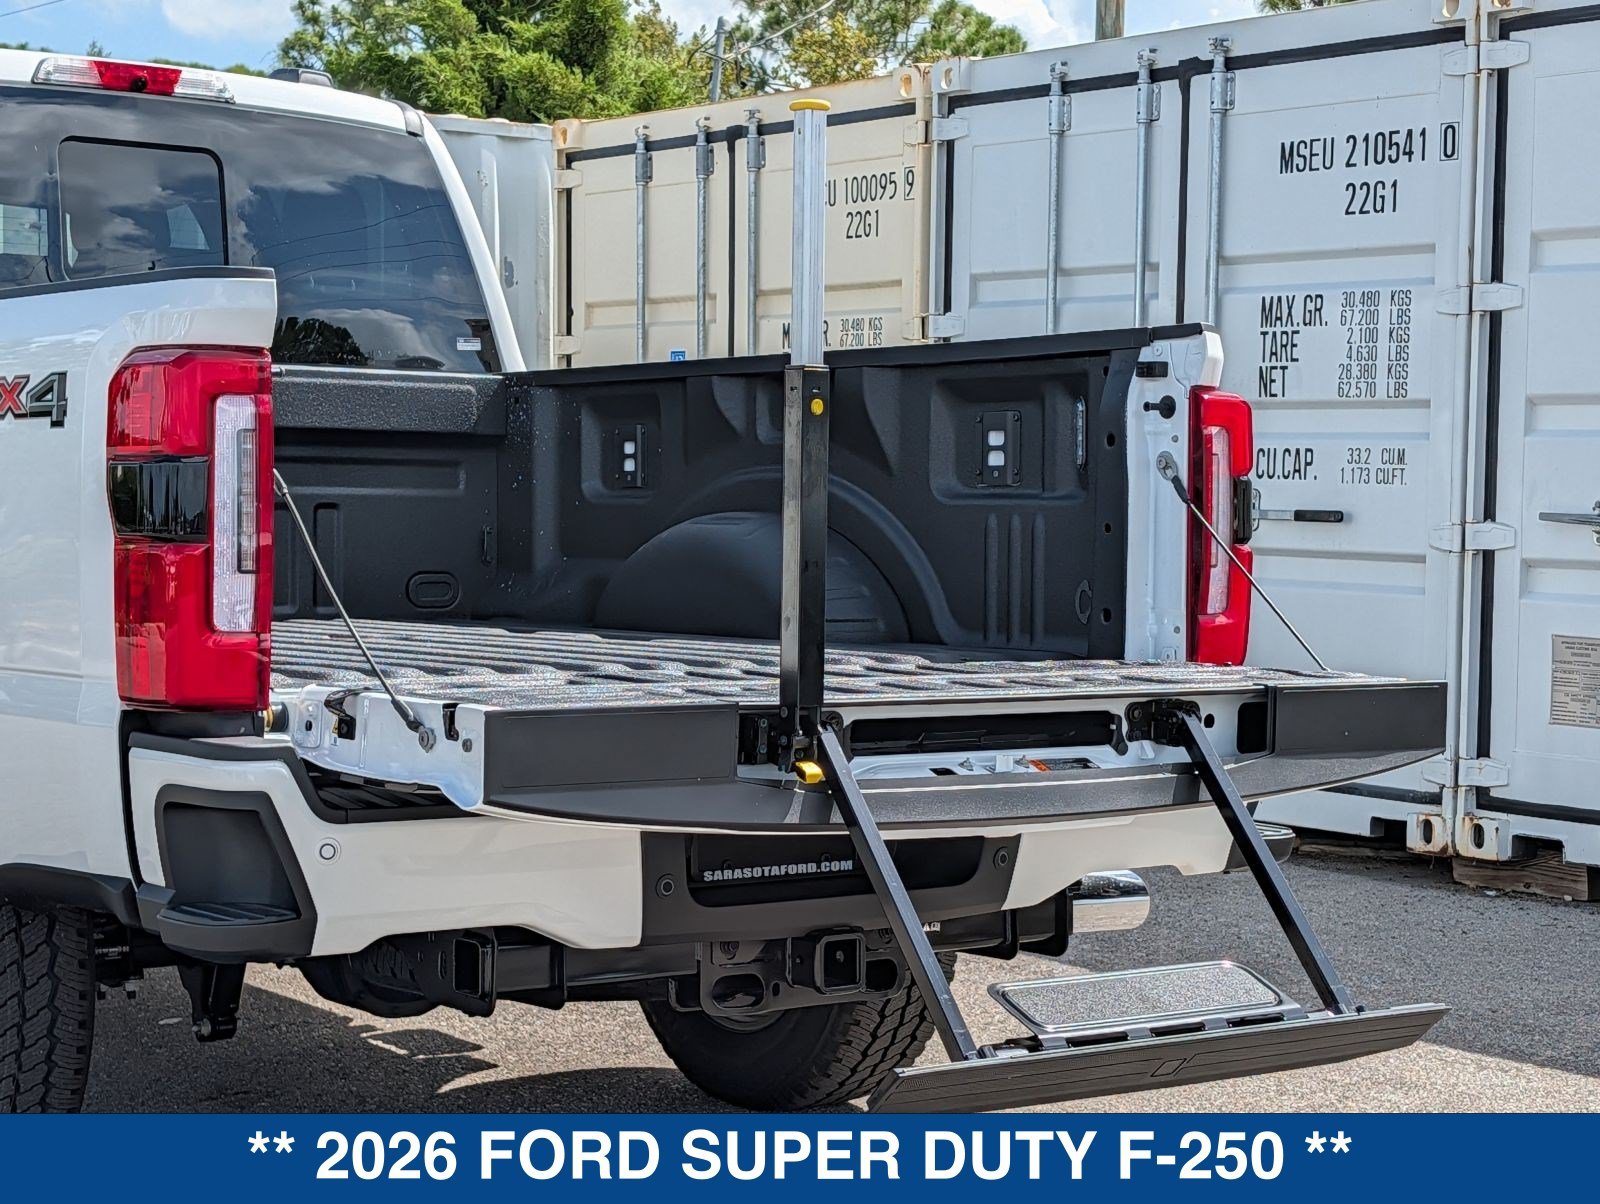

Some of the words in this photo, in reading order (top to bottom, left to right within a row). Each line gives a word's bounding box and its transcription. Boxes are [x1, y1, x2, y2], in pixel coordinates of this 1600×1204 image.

[1280, 136, 1335, 174] MSEU
[1344, 126, 1426, 168] 210541
[1442, 124, 1457, 159] 0
[825, 179, 836, 207] U
[844, 172, 898, 205] 100095
[906, 169, 915, 198] 9
[1344, 178, 1398, 216] 22G1
[846, 209, 879, 239] 22G1
[1341, 290, 1380, 308] 30.480
[1390, 289, 1412, 307] KGS
[868, 316, 883, 331] KGS
[1340, 309, 1380, 326] 67.200
[1389, 308, 1411, 326] LBS
[868, 332, 882, 346] LBS
[1346, 327, 1379, 344] 2.100
[1388, 326, 1410, 344] KGS
[1260, 330, 1300, 363] TARE
[1345, 345, 1378, 362] 4.630
[1388, 345, 1410, 362] LBS
[1338, 363, 1377, 381] 28.380
[1387, 363, 1409, 380] KGS
[1258, 366, 1289, 398] NET
[1337, 381, 1377, 399] 62.570
[1386, 381, 1408, 399] LBS
[1255, 448, 1318, 481] CU.CAP.
[1347, 448, 1371, 464] 33.2
[1340, 468, 1370, 484] 1.173
[703, 860, 853, 882] SARASOTAFORD.COM
